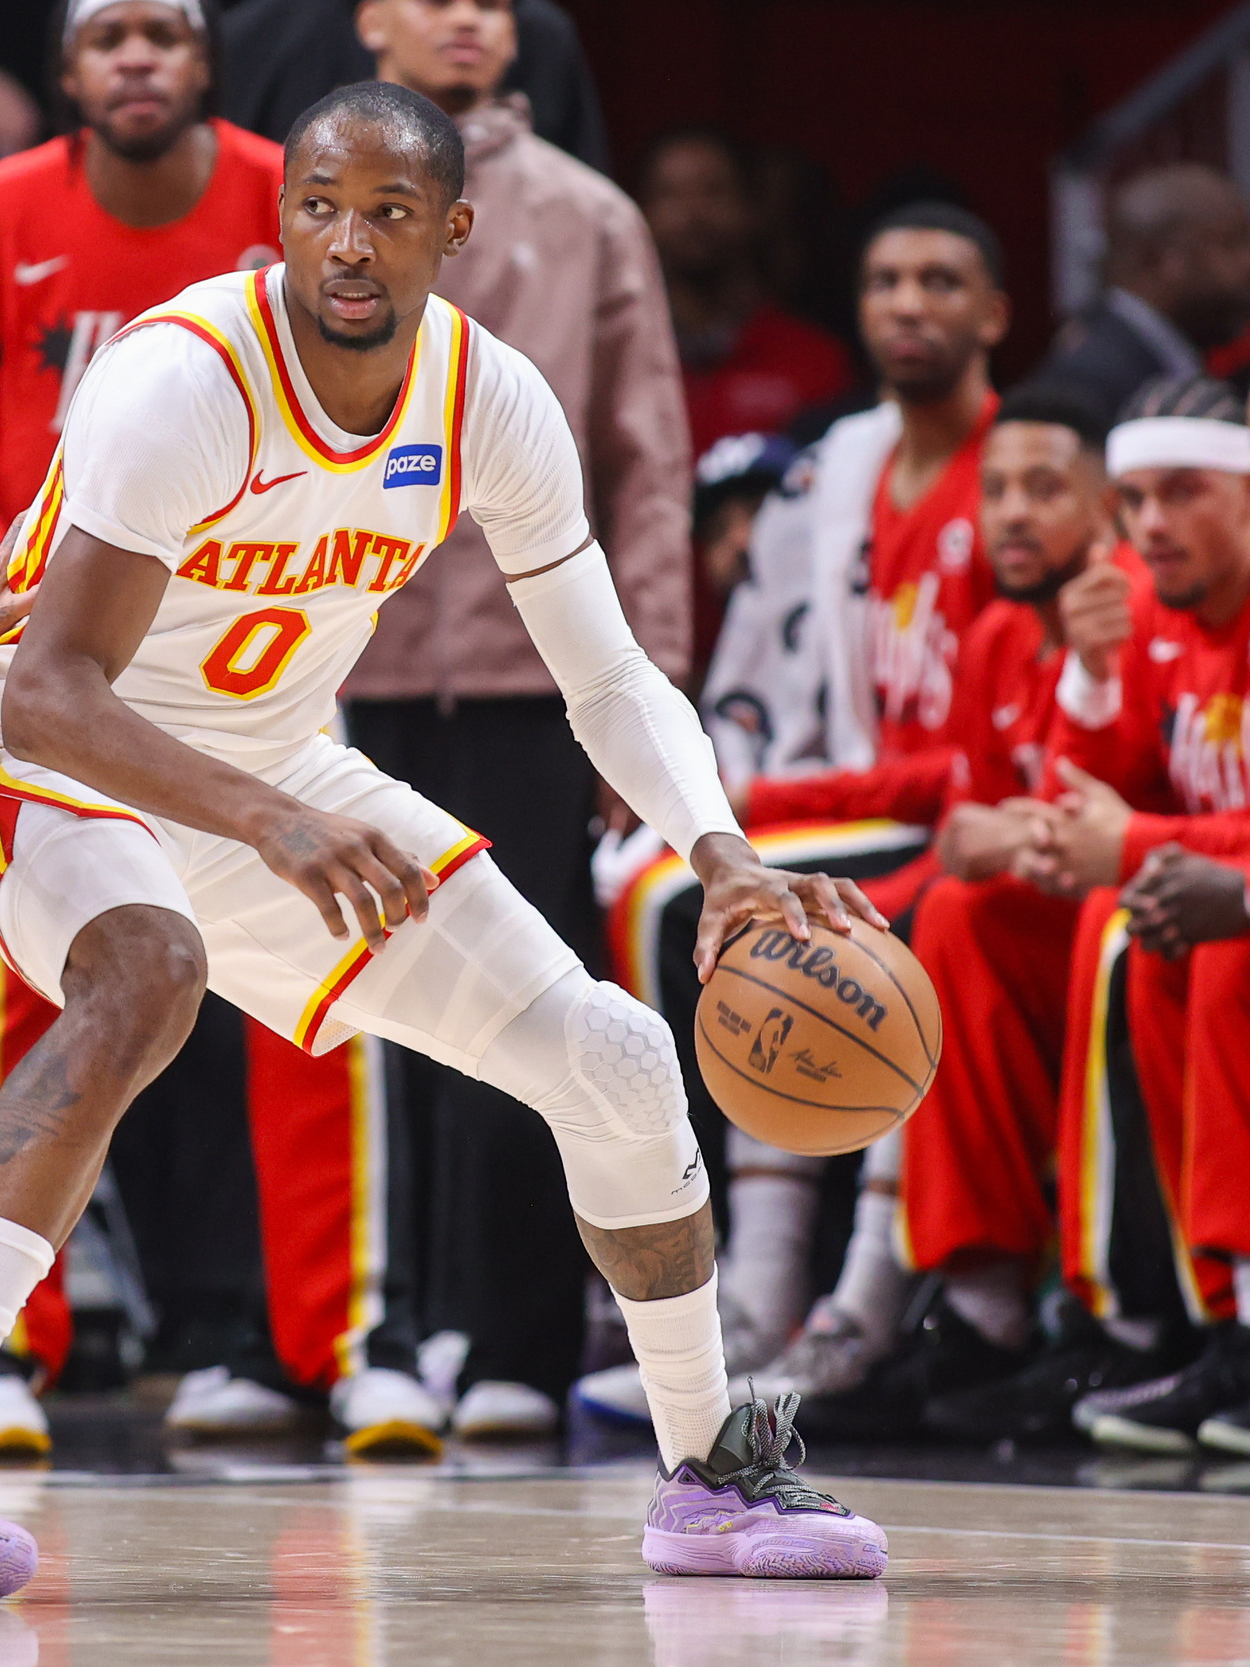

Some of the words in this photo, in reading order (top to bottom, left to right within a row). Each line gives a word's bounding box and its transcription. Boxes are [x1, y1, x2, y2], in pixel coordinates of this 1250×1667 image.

[386, 454, 437, 480] paze
[171, 527, 429, 597] ATLANTA
[198, 605, 313, 701] 0
[749, 929, 889, 1033] Wilson
